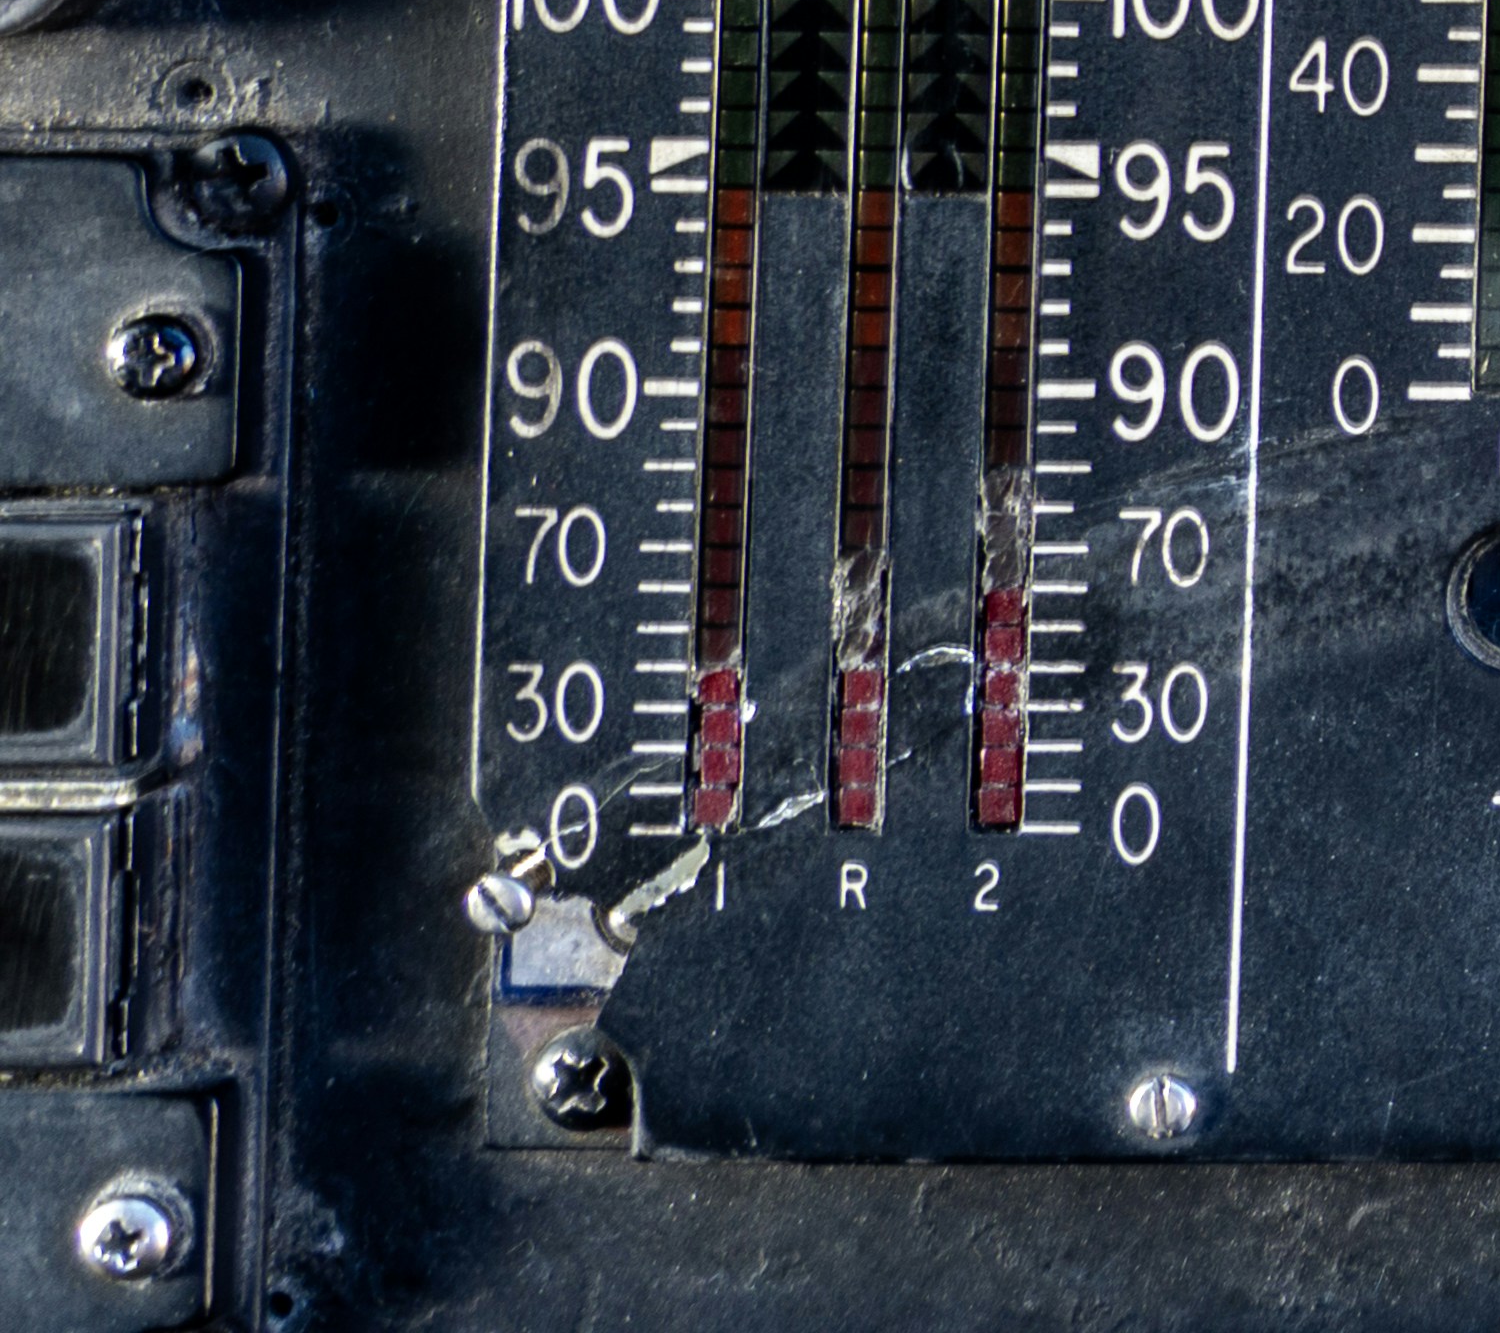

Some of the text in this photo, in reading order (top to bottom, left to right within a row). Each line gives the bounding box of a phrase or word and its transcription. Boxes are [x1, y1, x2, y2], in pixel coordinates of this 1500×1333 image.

[1289, 38, 1389, 116] 40
[512, 138, 635, 238] 95
[1114, 141, 1236, 242] 95
[1285, 195, 1385, 274] 20
[507, 339, 639, 438] 90
[1108, 340, 1241, 443] 90
[1333, 357, 1379, 435] 0
[514, 506, 606, 586] 70
[1119, 506, 1209, 588] 70
[506, 662, 604, 743] 30
[1112, 662, 1209, 743] 30
[550, 783, 598, 869] 0
[1112, 783, 1160, 866] 0
[841, 864, 867, 909] R
[974, 864, 1000, 912] 2
